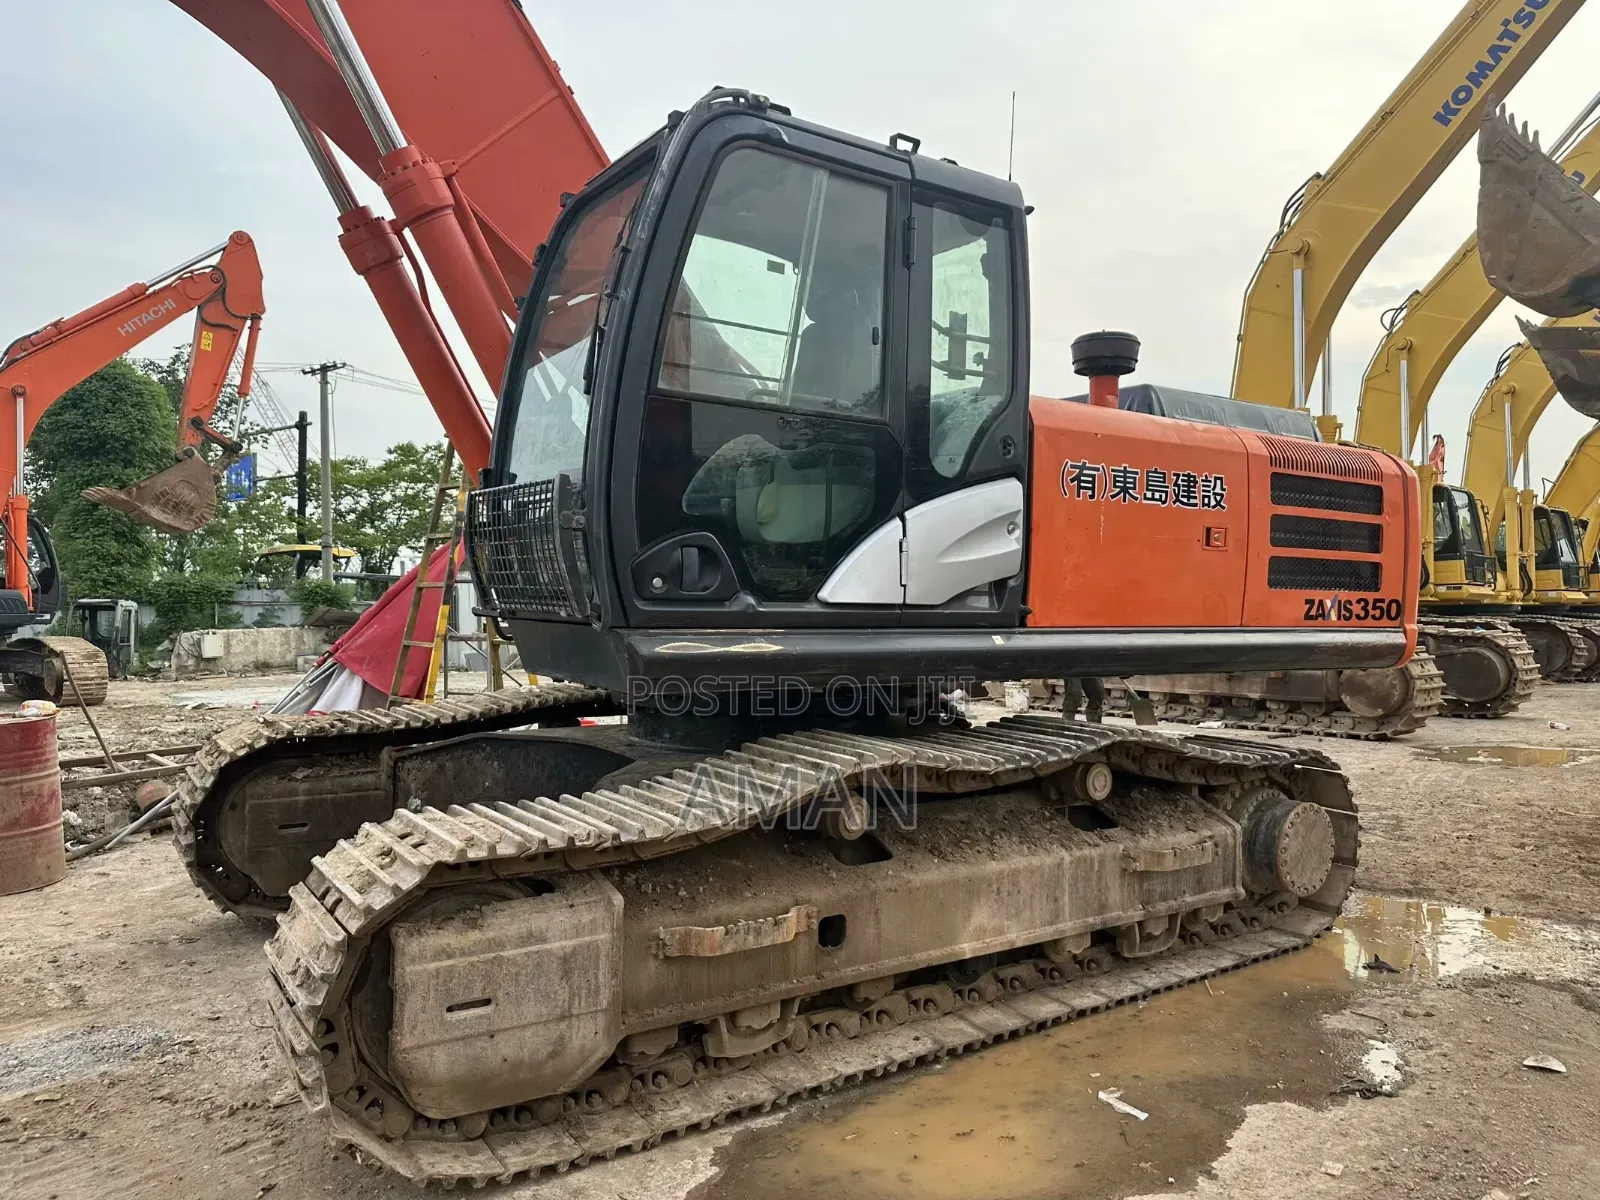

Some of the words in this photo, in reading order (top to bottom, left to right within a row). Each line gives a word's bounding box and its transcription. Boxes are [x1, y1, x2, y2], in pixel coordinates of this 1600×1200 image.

[117, 298, 176, 336] HITACHI
[1060, 459, 1228, 512] (有)東島建設
